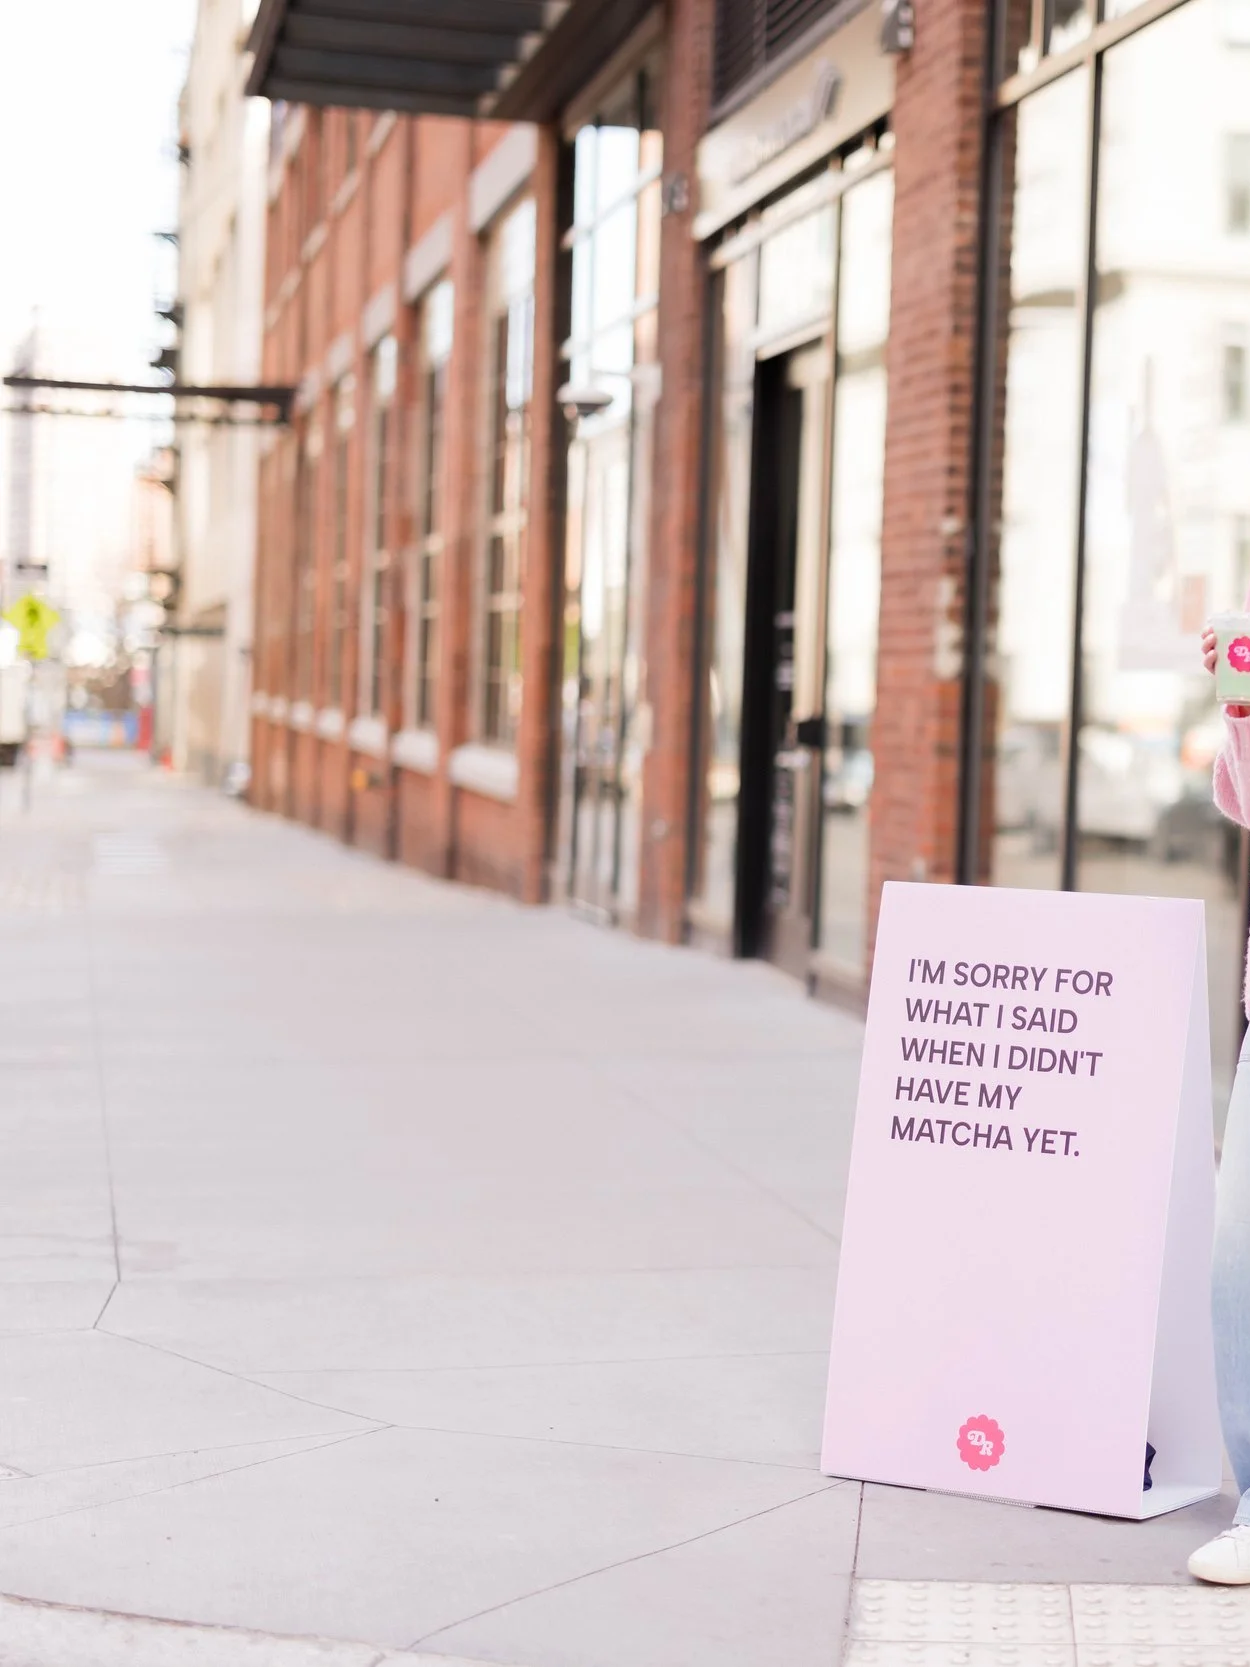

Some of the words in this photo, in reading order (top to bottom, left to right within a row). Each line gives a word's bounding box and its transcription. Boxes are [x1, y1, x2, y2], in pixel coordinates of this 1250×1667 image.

[908, 958, 946, 985] I'M
[953, 961, 1049, 992] SORRY
[1054, 968, 1114, 997] FOR
[905, 997, 990, 1028] WHAT
[996, 1004, 1004, 1029] I
[1011, 1005, 1078, 1034] SAID
[900, 1036, 986, 1068] WHEN
[993, 1044, 1001, 1069] I
[1007, 1045, 1104, 1077] DIDN'T
[895, 1076, 971, 1107] HAVE
[977, 1082, 1023, 1111] MY
[890, 1115, 1014, 1151] MATCHA
[1023, 1127, 1080, 1157] YET.
[967, 1430, 994, 1456] DR
